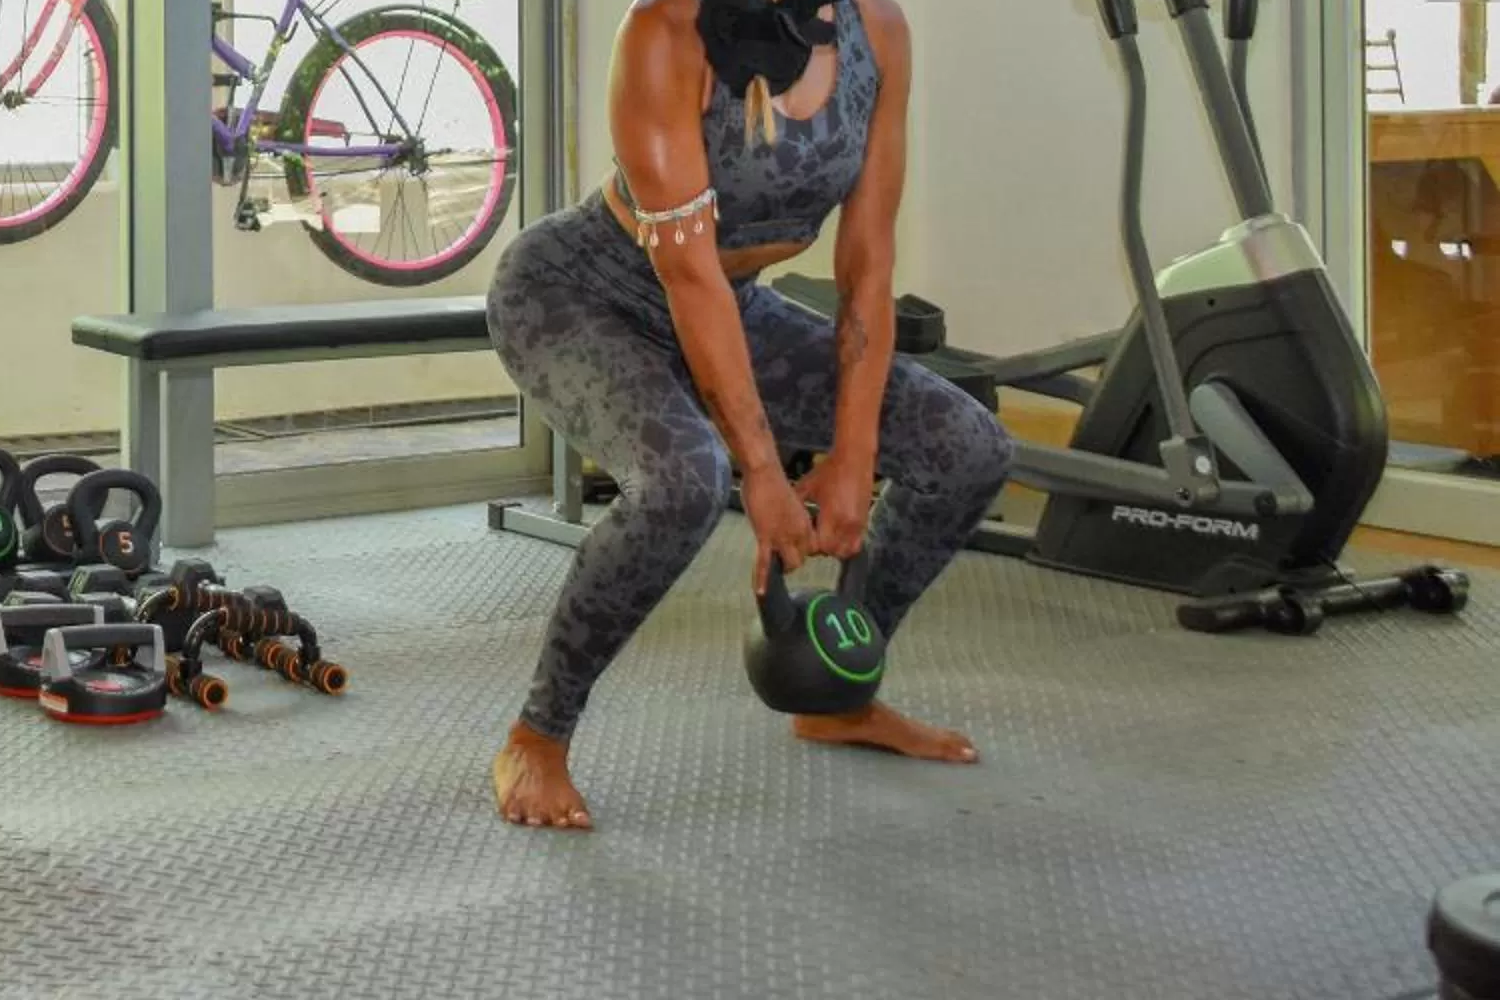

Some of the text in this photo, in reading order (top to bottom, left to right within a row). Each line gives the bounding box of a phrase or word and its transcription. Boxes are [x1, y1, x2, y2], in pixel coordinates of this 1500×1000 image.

[1111, 505, 1259, 541] PRO-FORM
[118, 531, 134, 554] 5
[825, 609, 871, 650] 10
